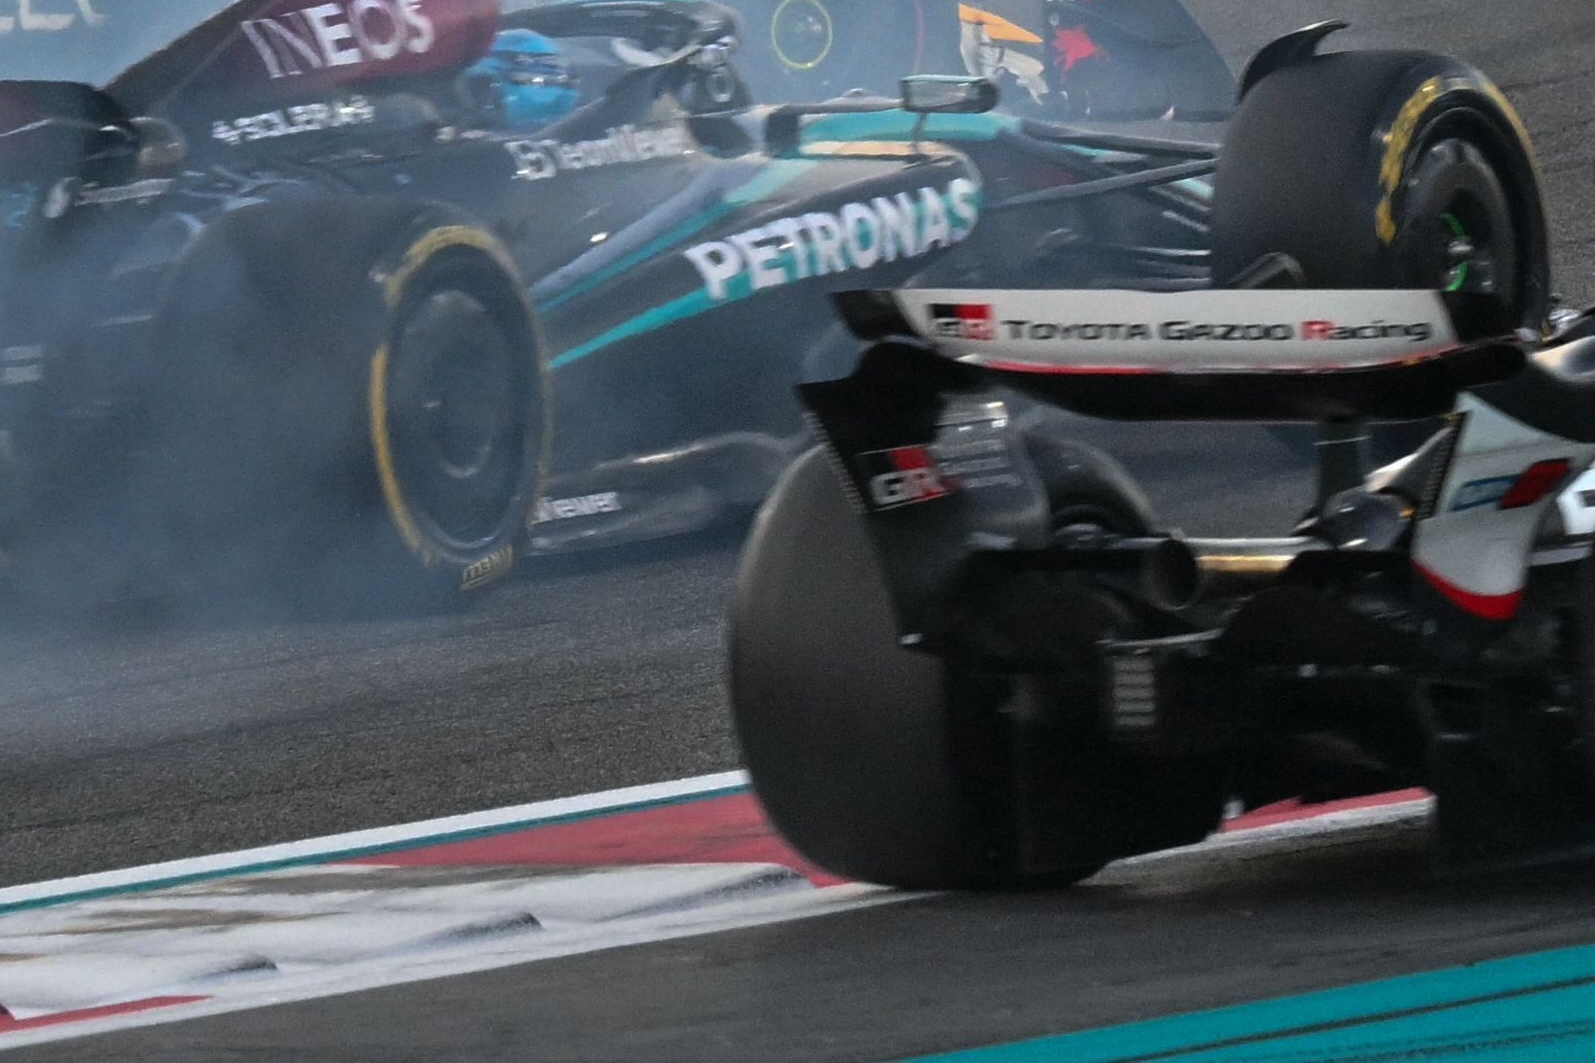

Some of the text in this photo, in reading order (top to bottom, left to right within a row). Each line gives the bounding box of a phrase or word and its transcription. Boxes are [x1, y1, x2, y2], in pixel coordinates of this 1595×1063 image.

[683, 177, 979, 301] PETRONAS
[1300, 319, 1432, 343] Racing
[869, 467, 947, 505] GR
